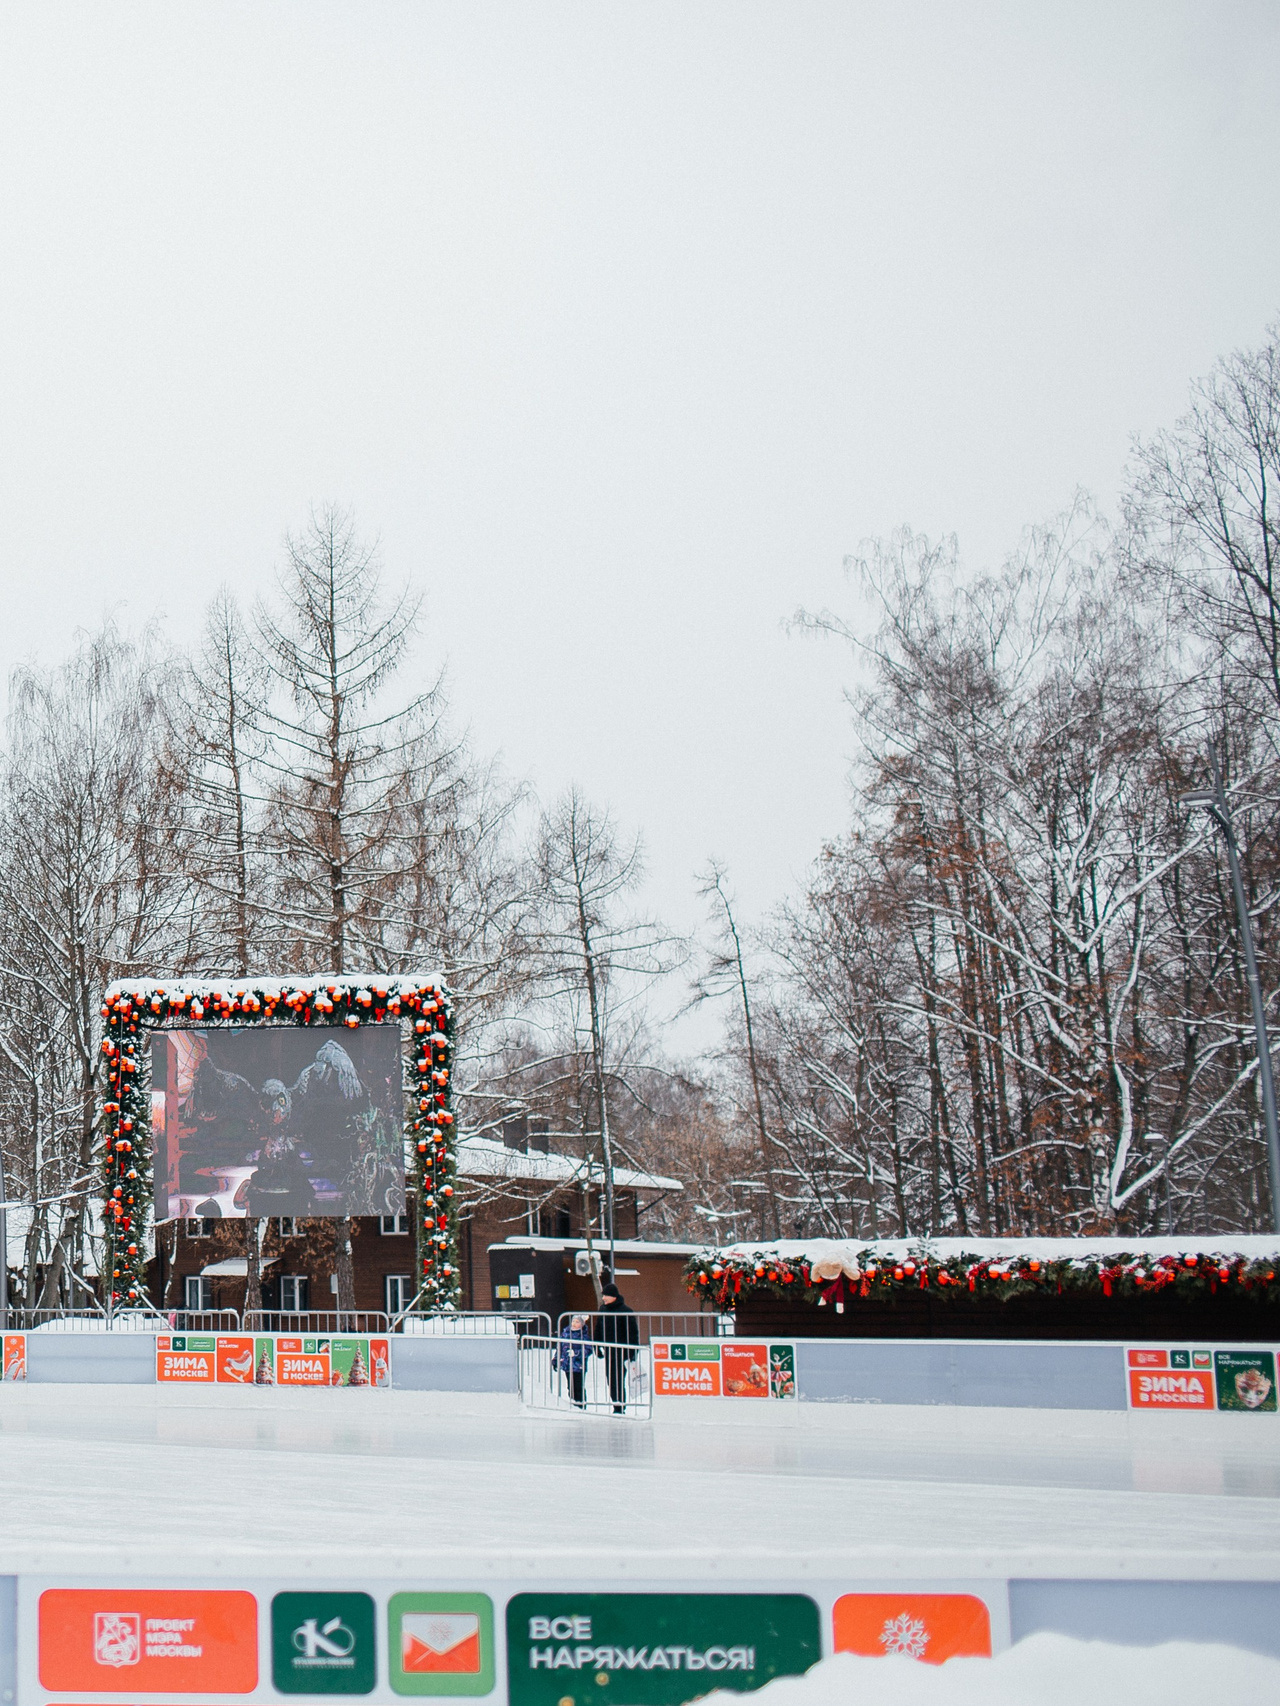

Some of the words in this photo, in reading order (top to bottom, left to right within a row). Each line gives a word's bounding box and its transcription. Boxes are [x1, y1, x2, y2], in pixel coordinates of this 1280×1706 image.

[164, 1357, 208, 1369] ЗИМА
[283, 1359, 323, 1372] ЗИМА
[662, 1368, 712, 1381] ЗИМА
[662, 1382, 669, 1390] В
[672, 1382, 713, 1391] МОСКВЕ
[1138, 1376, 1204, 1393] ЗИМА
[1140, 1393, 1150, 1402] В
[1152, 1393, 1205, 1403] МОСКВЕ
[146, 1619, 196, 1632] ПРОЕКТ
[529, 1616, 592, 1639] ВСЕ
[146, 1632, 182, 1644] МЭРА
[146, 1645, 203, 1657] МОСКВЫ
[529, 1646, 756, 1670] НАРЯЖАТЬСЯ!
